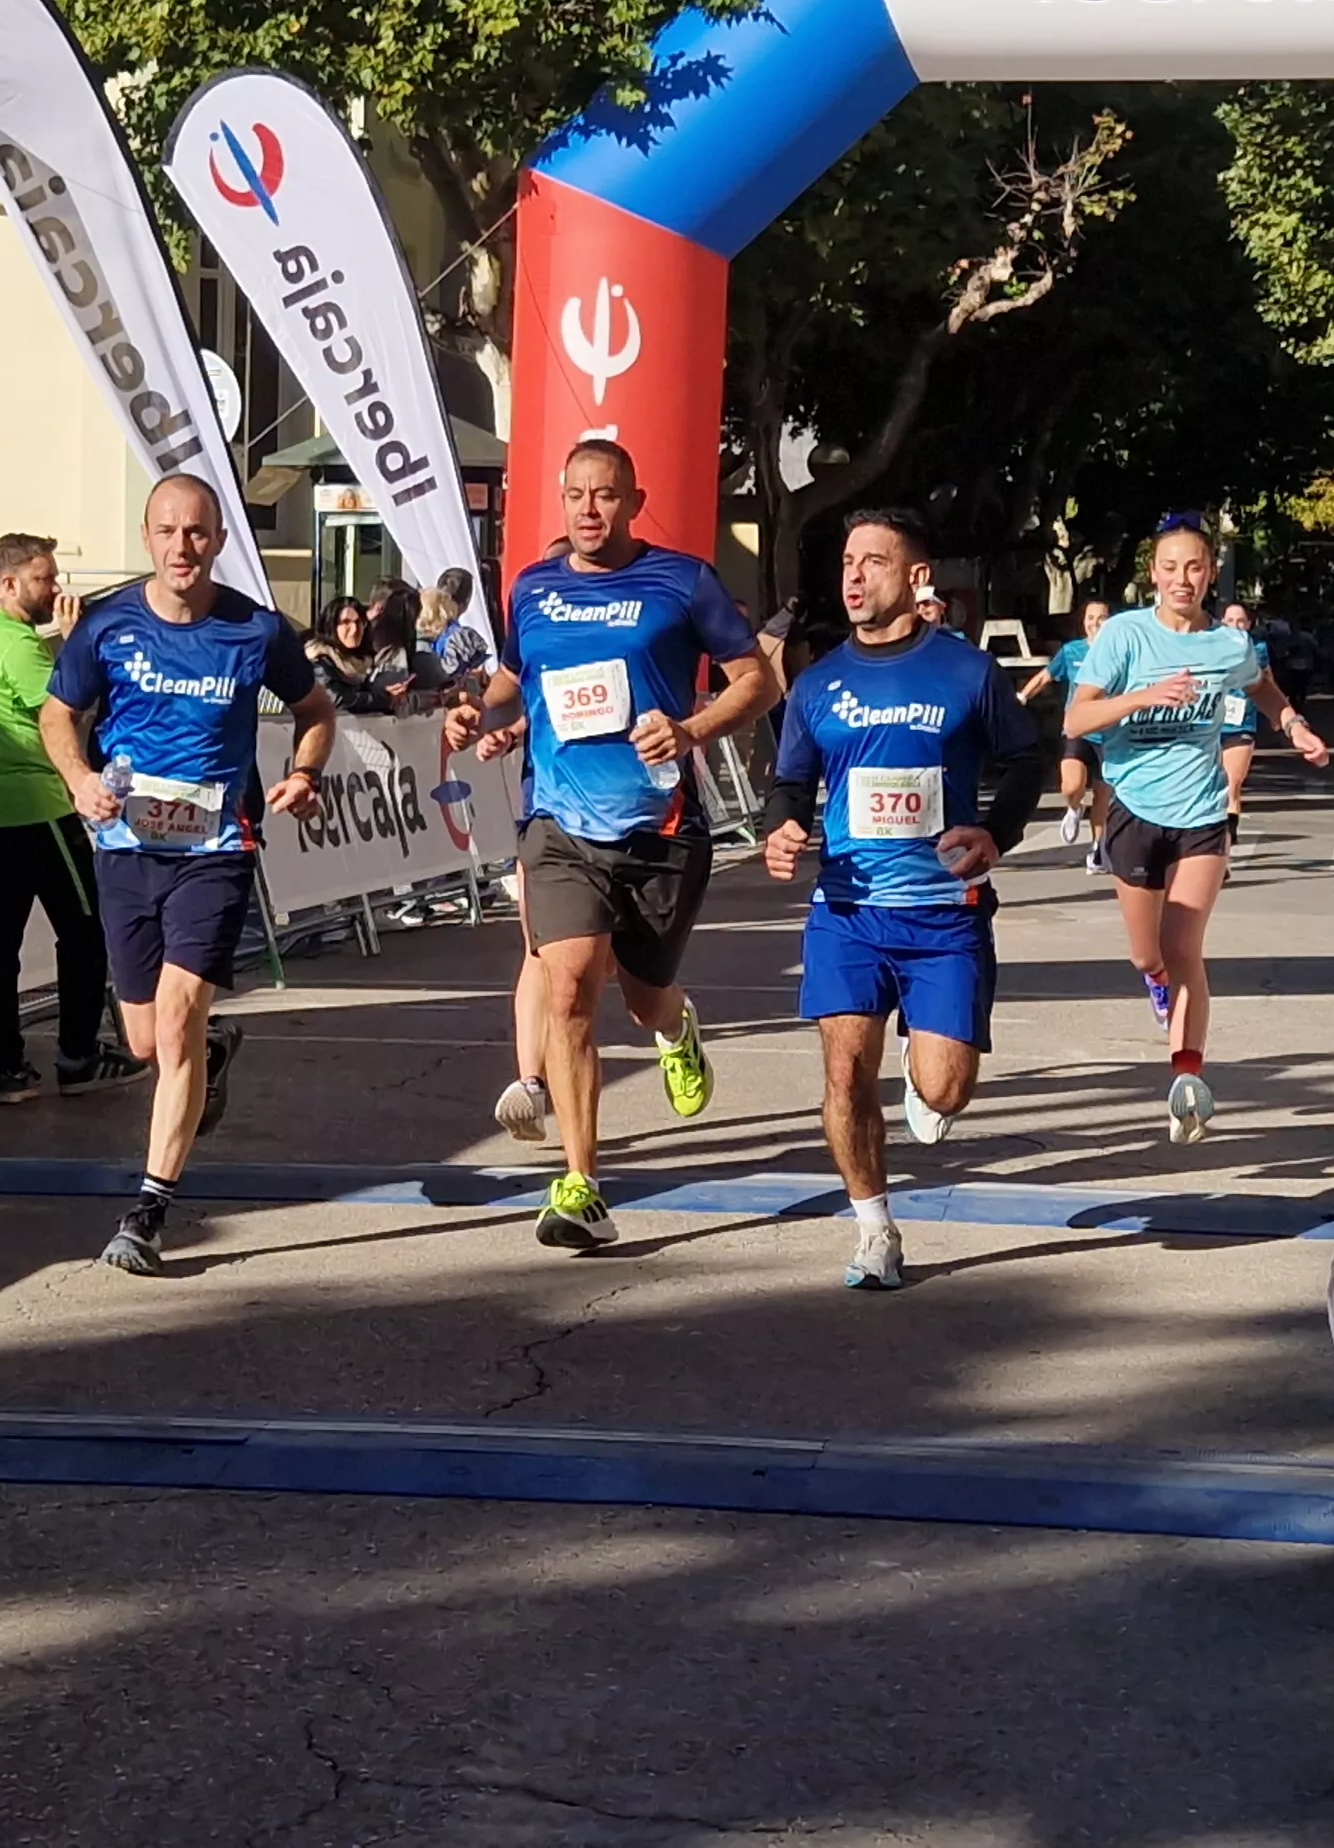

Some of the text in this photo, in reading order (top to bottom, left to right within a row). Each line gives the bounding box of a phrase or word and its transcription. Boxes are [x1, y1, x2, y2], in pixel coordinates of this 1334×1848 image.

[550, 600, 643, 623] CleanPill
[140, 671, 236, 698] CleanPill
[563, 683, 609, 709] 369
[847, 702, 946, 729] CleanPill
[146, 796, 197, 822] 371
[869, 792, 922, 814] 370
[871, 815, 921, 825] MIGUEL
